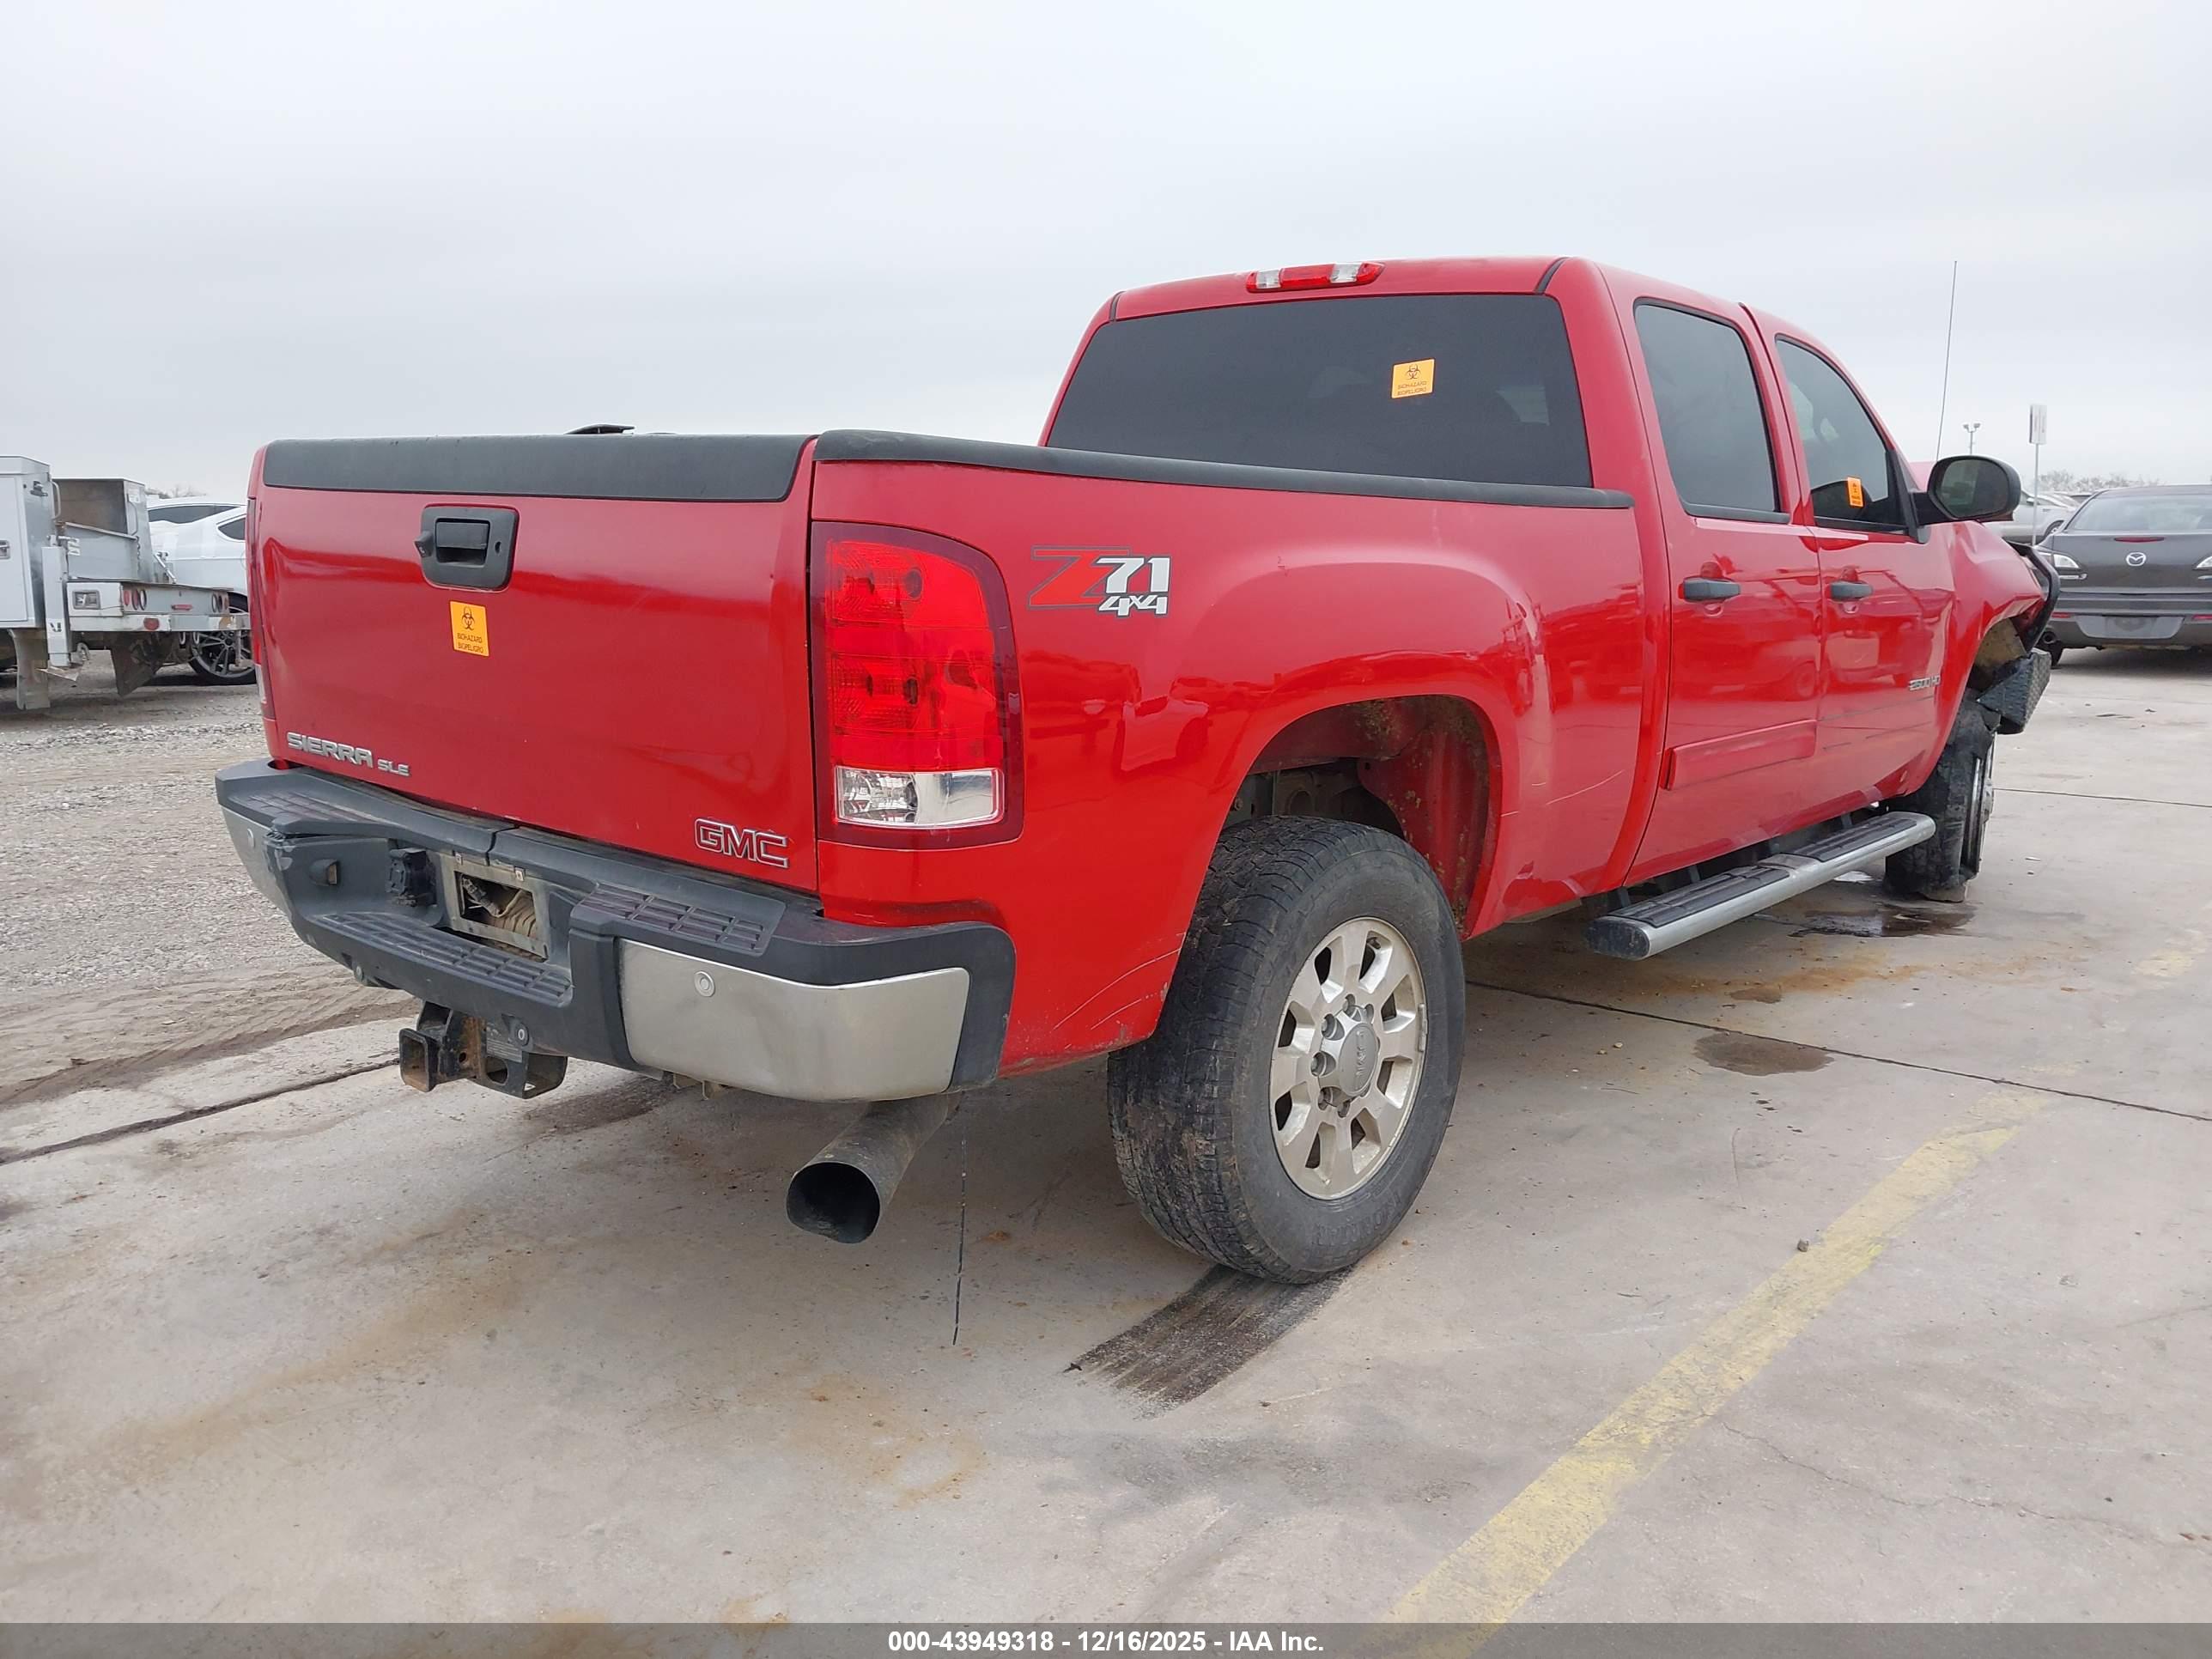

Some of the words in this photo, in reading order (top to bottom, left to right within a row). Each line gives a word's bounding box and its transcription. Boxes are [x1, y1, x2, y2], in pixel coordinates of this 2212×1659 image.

[1027, 545, 1172, 610] Z71
[287, 732, 374, 769] SIERRA
[377, 758, 410, 776] SLE
[694, 817, 789, 869] GMC
